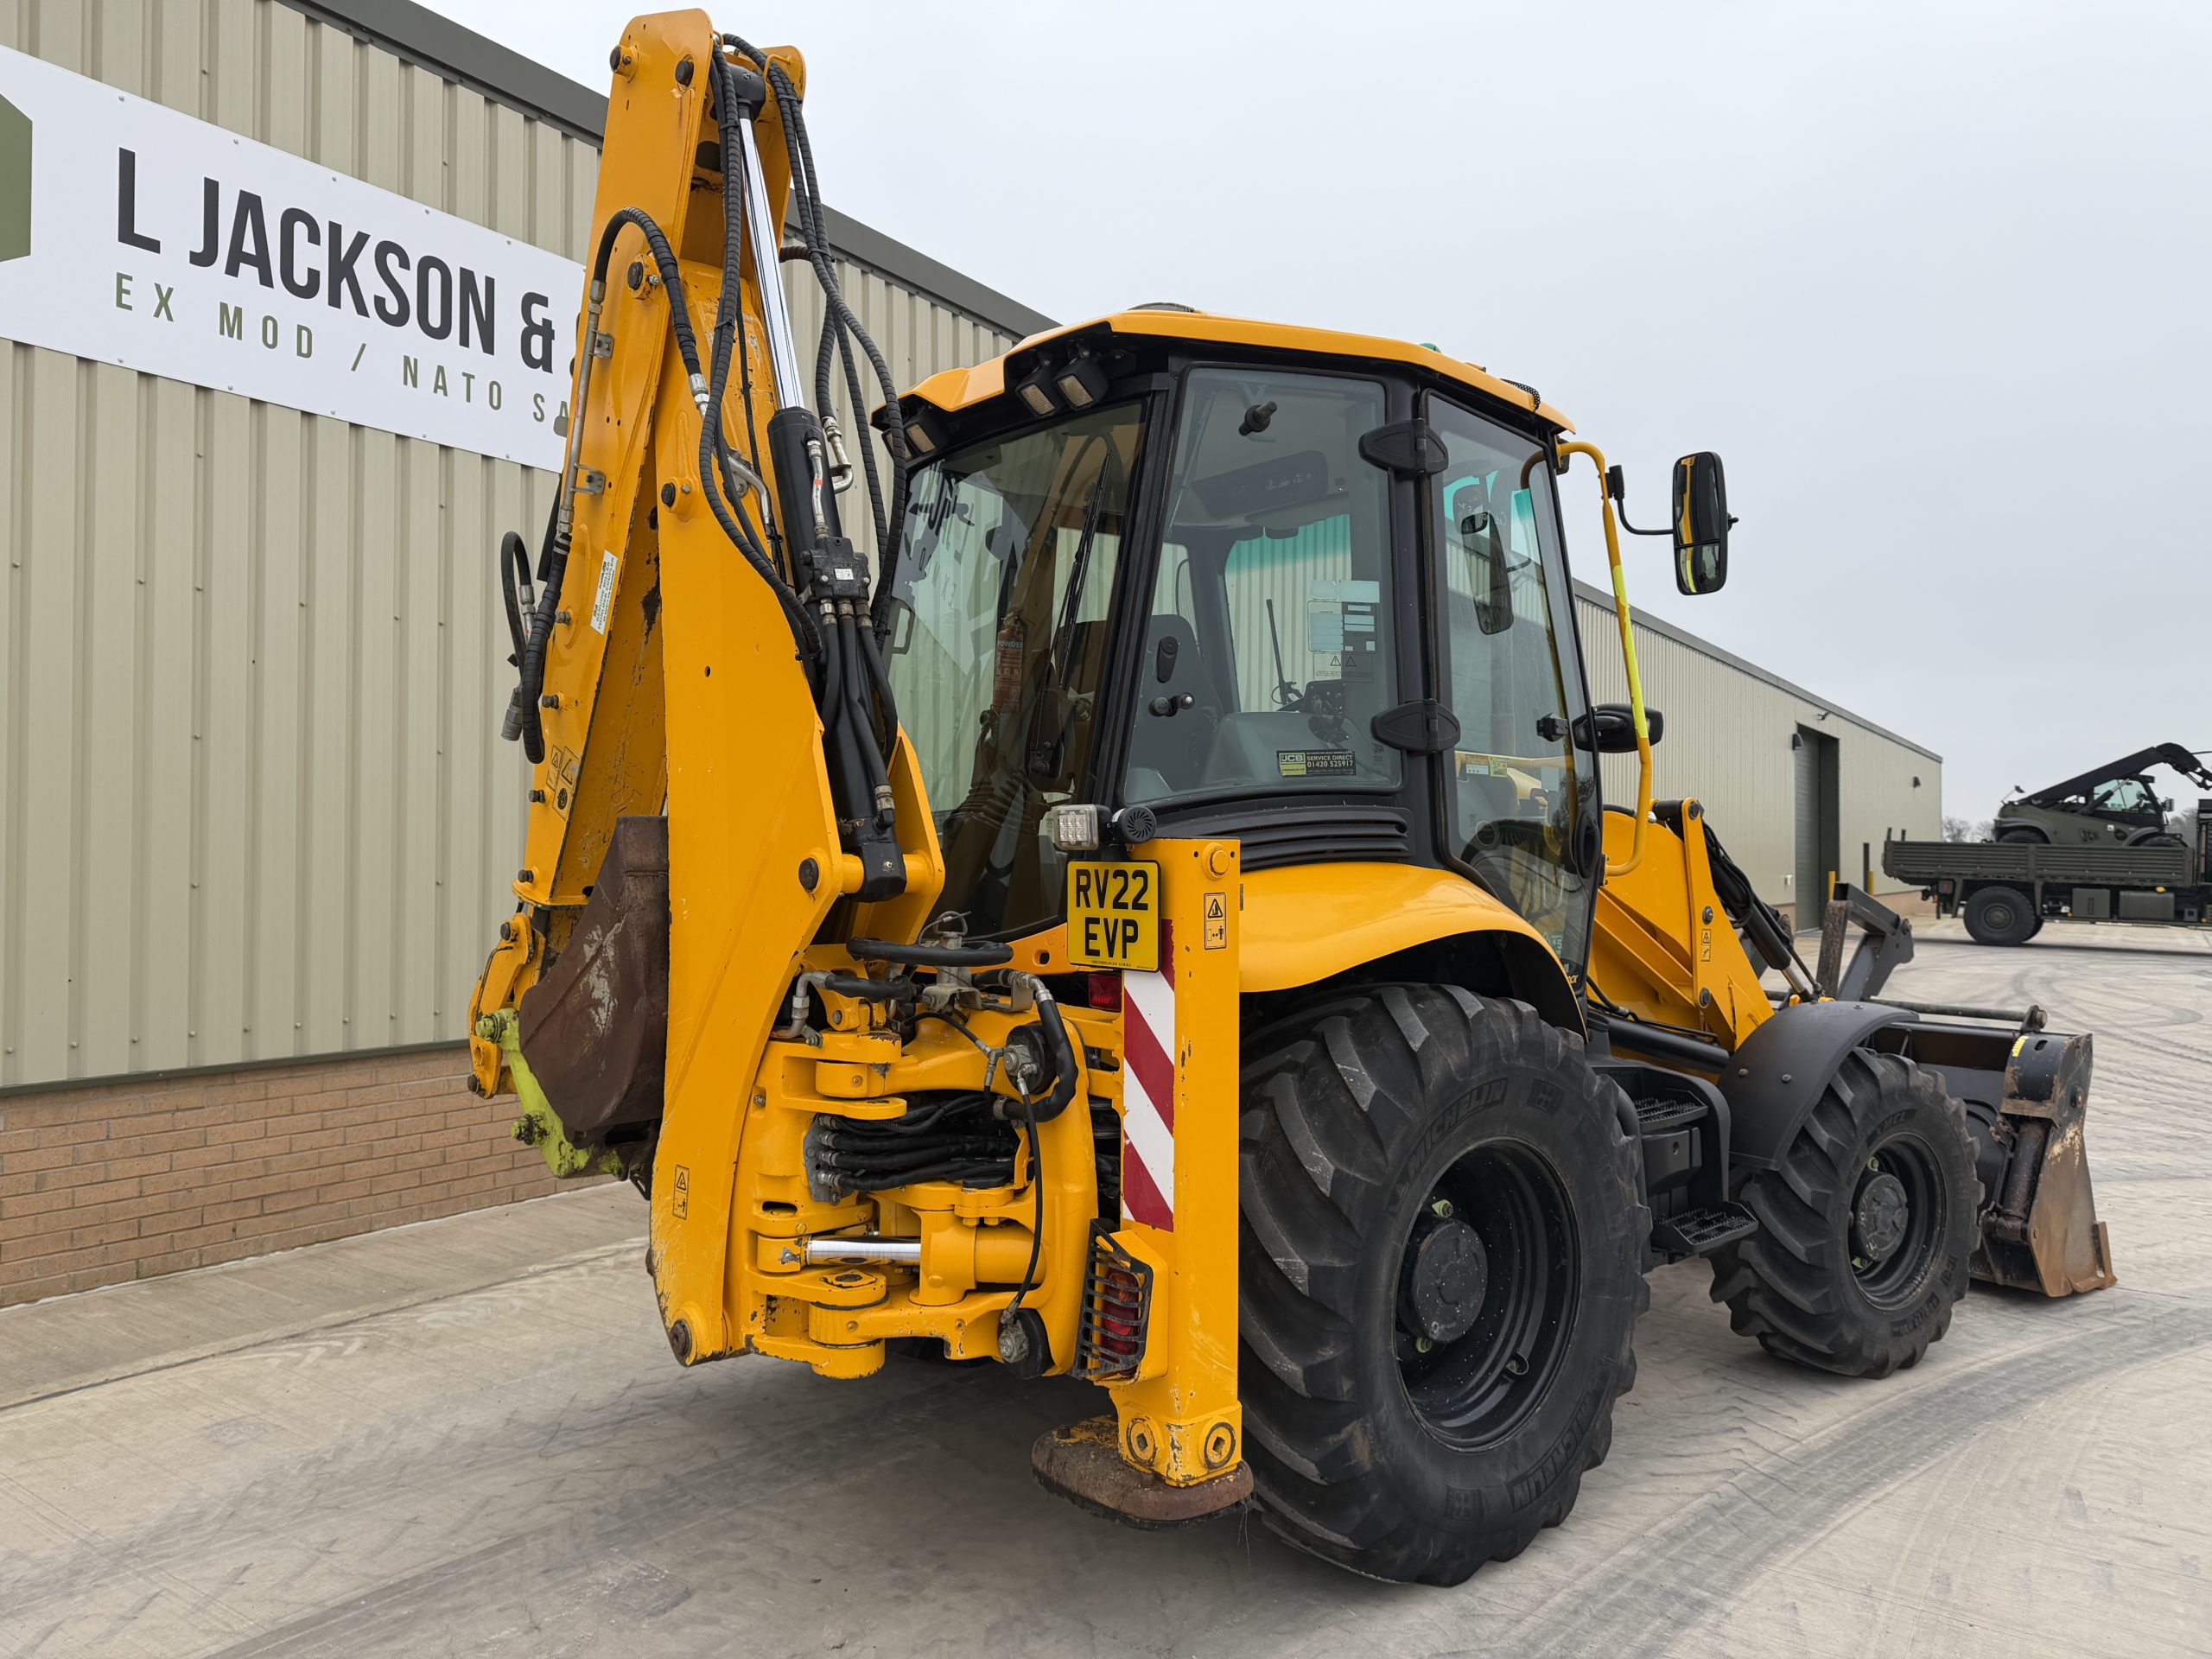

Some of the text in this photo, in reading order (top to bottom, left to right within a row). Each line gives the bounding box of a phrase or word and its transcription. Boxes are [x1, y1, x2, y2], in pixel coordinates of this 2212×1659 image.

[118, 147, 161, 254] L
[189, 177, 495, 356] JACKSON
[521, 292, 556, 374] &
[117, 272, 175, 322] EX
[219, 302, 313, 359] MOD
[403, 355, 502, 410] NATO
[532, 392, 569, 423] SA
[1076, 868, 1148, 911] RV22
[1084, 916, 1139, 959] EVP
[1406, 1079, 1507, 1182] MICHELIN
